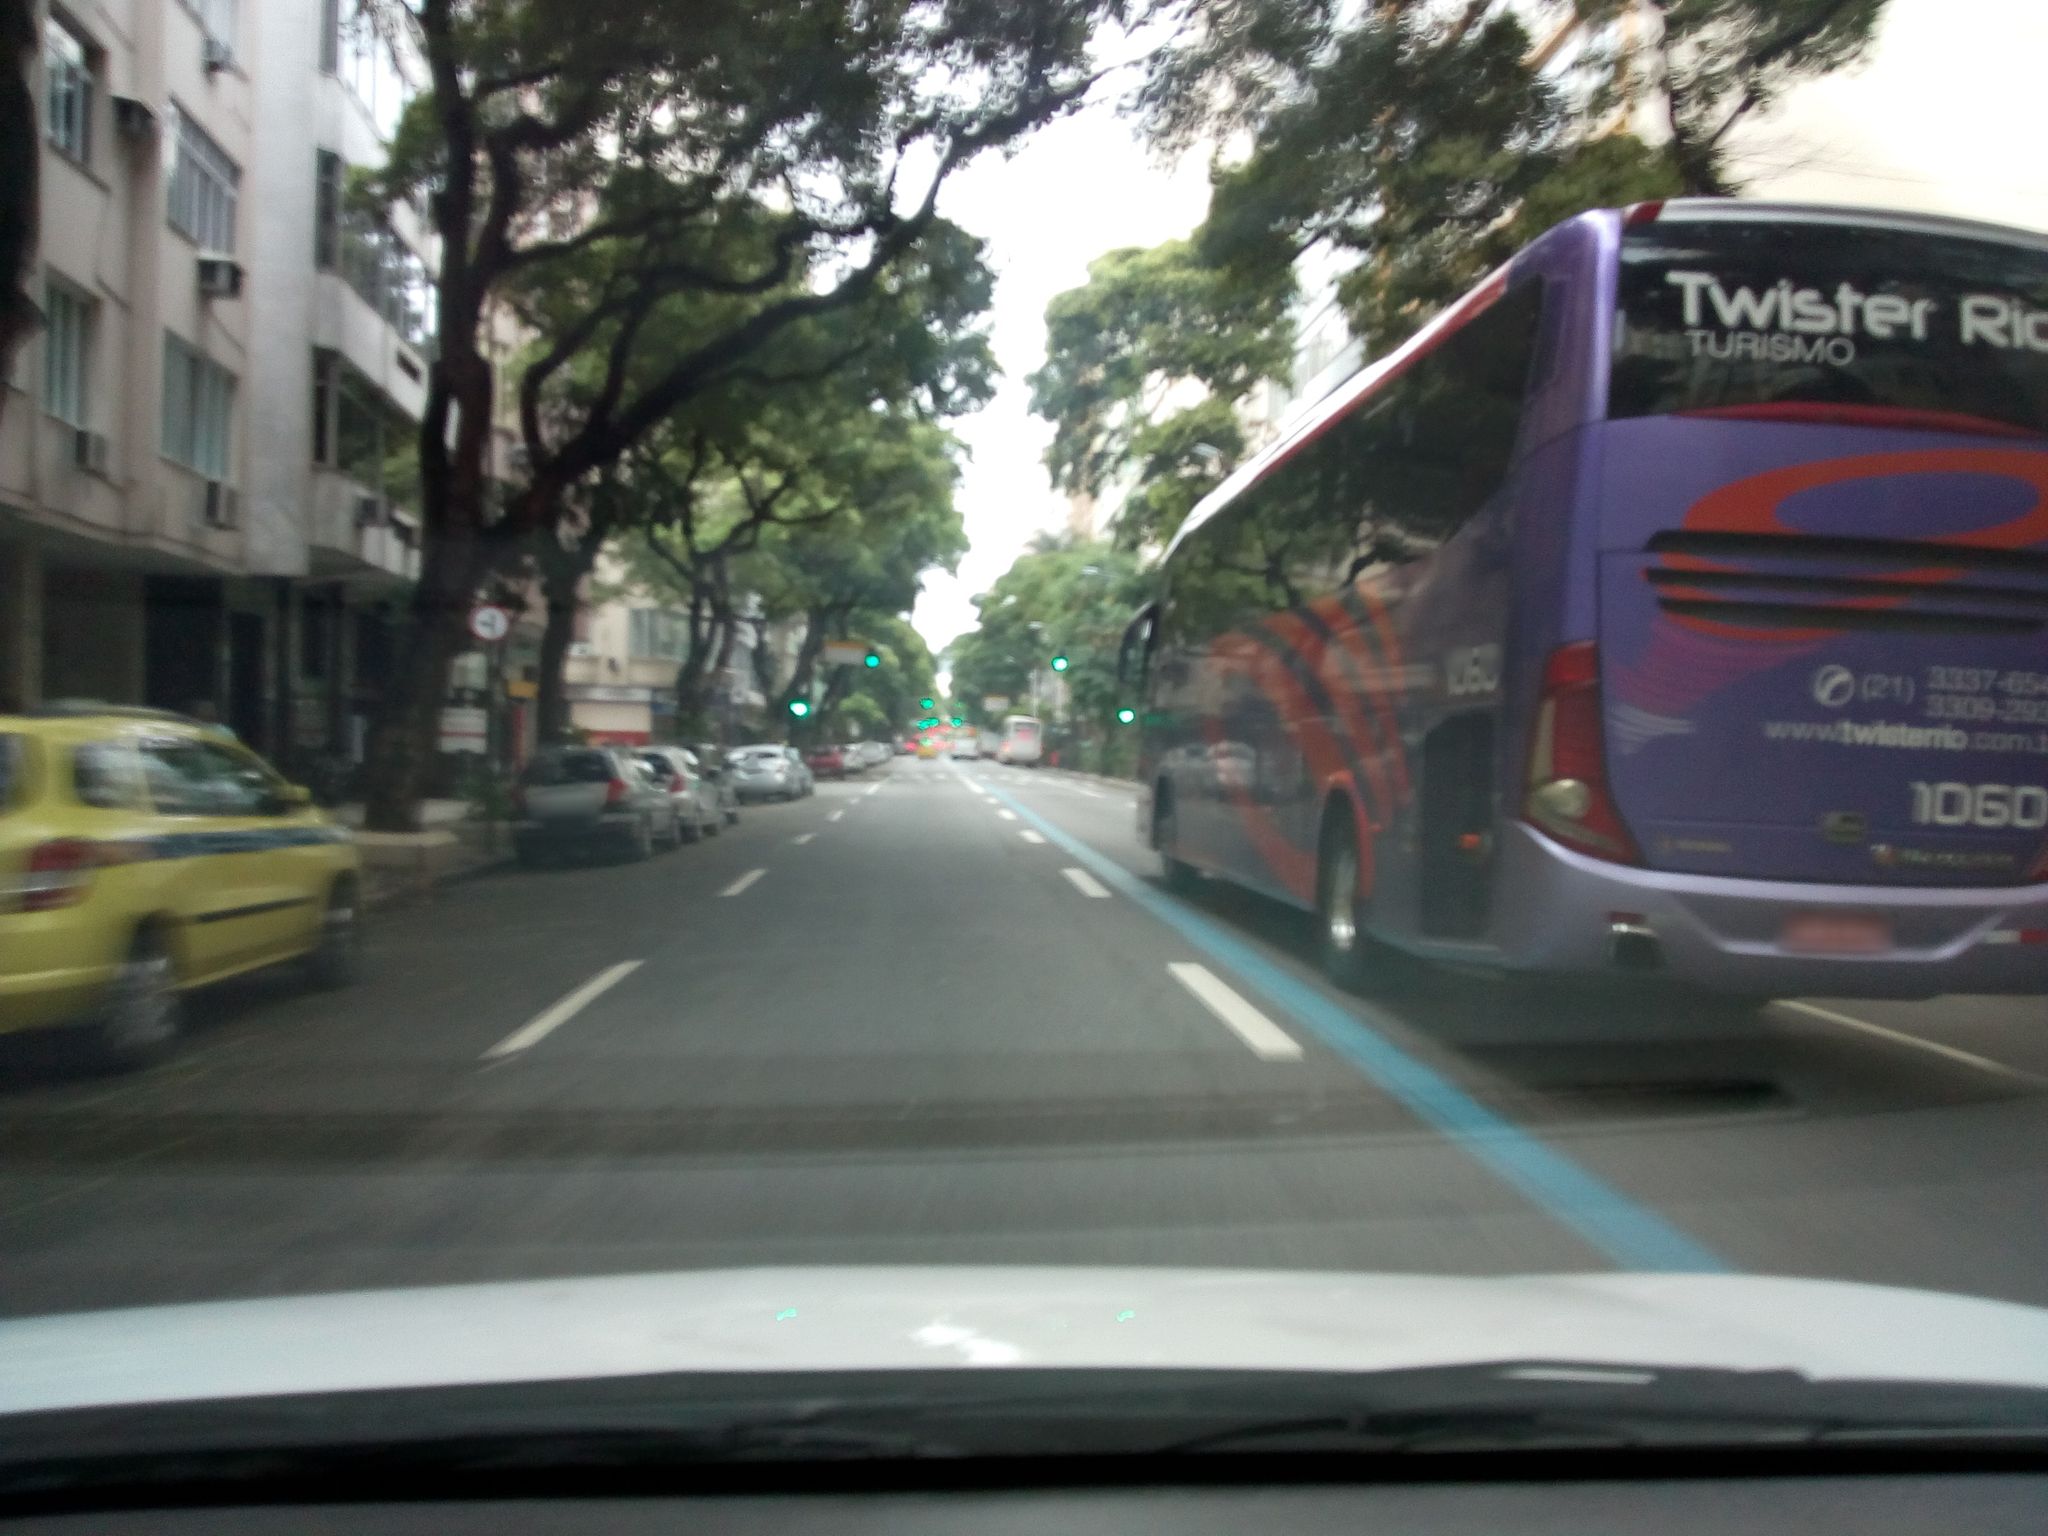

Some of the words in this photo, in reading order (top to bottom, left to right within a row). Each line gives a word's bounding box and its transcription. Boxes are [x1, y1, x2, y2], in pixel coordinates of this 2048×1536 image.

[1665, 269, 1937, 342] Twister
[1684, 328, 1857, 367] TURISMO
[1909, 780, 2048, 829] 1060
